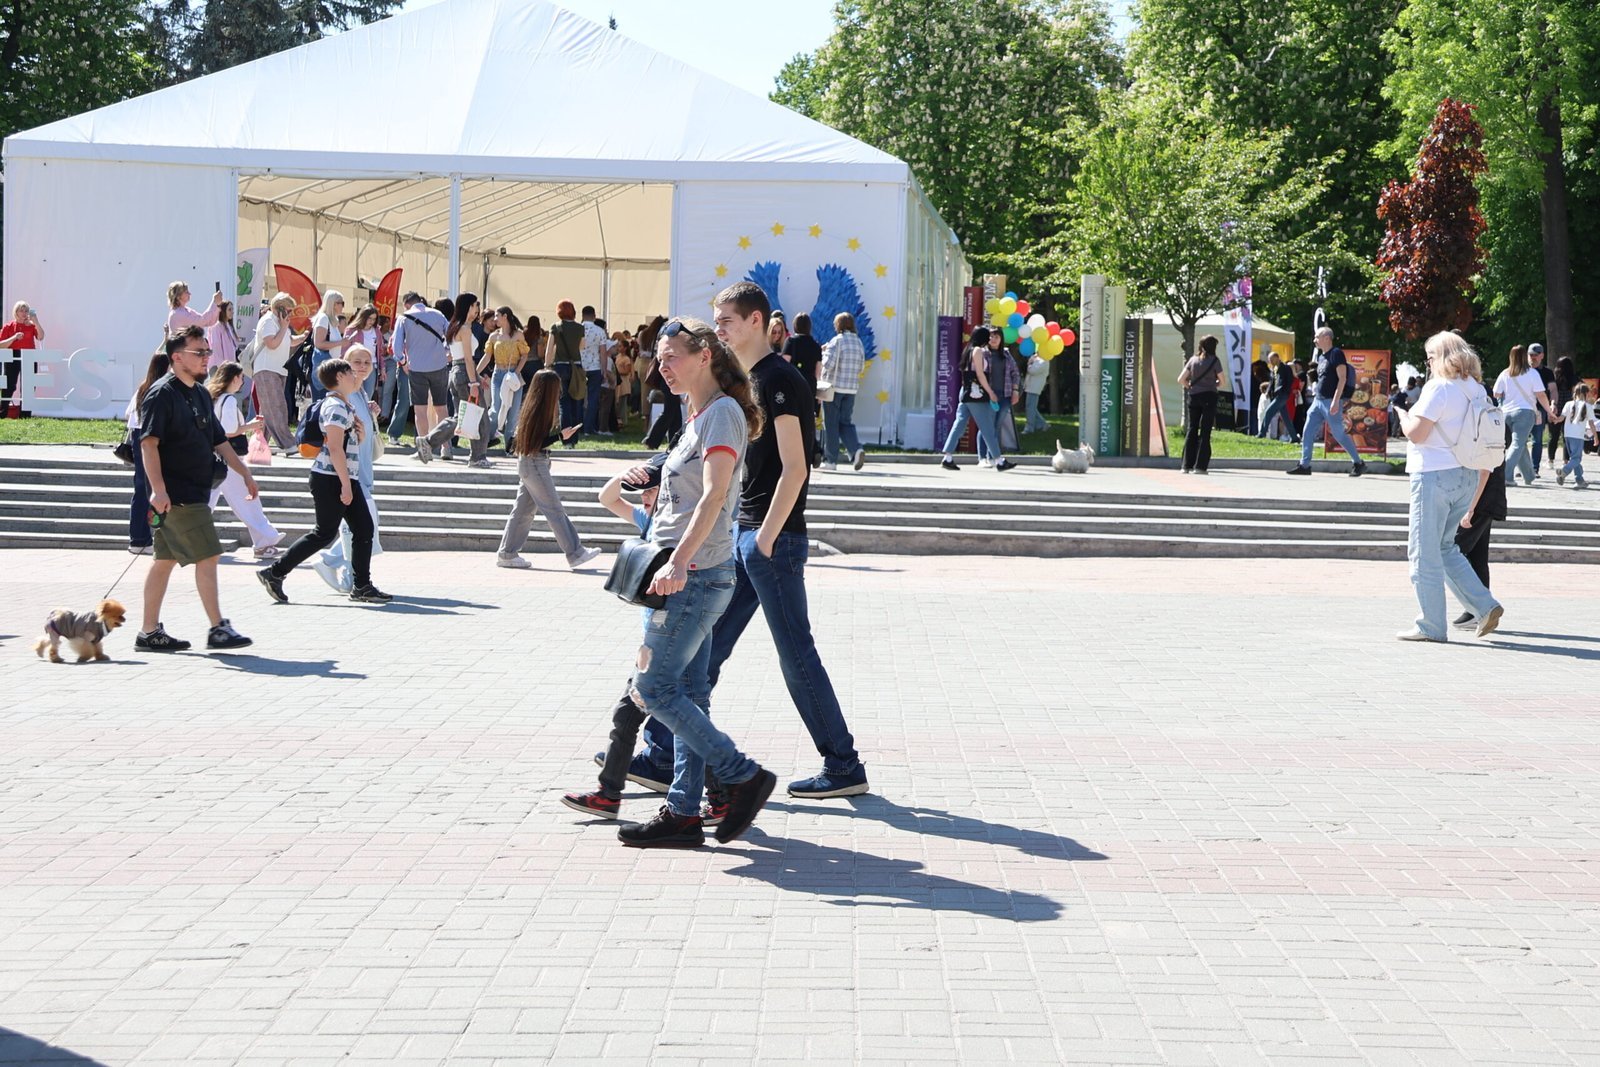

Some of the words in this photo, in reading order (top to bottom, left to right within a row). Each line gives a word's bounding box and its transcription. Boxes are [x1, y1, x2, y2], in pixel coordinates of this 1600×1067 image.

[1082, 300, 1094, 369] ЕНЕІДА
[1101, 369, 1113, 414] Лісова
[1125, 331, 1135, 405] ПАЛІМПСЕСТИ
[936, 385, 953, 414] Ромео
